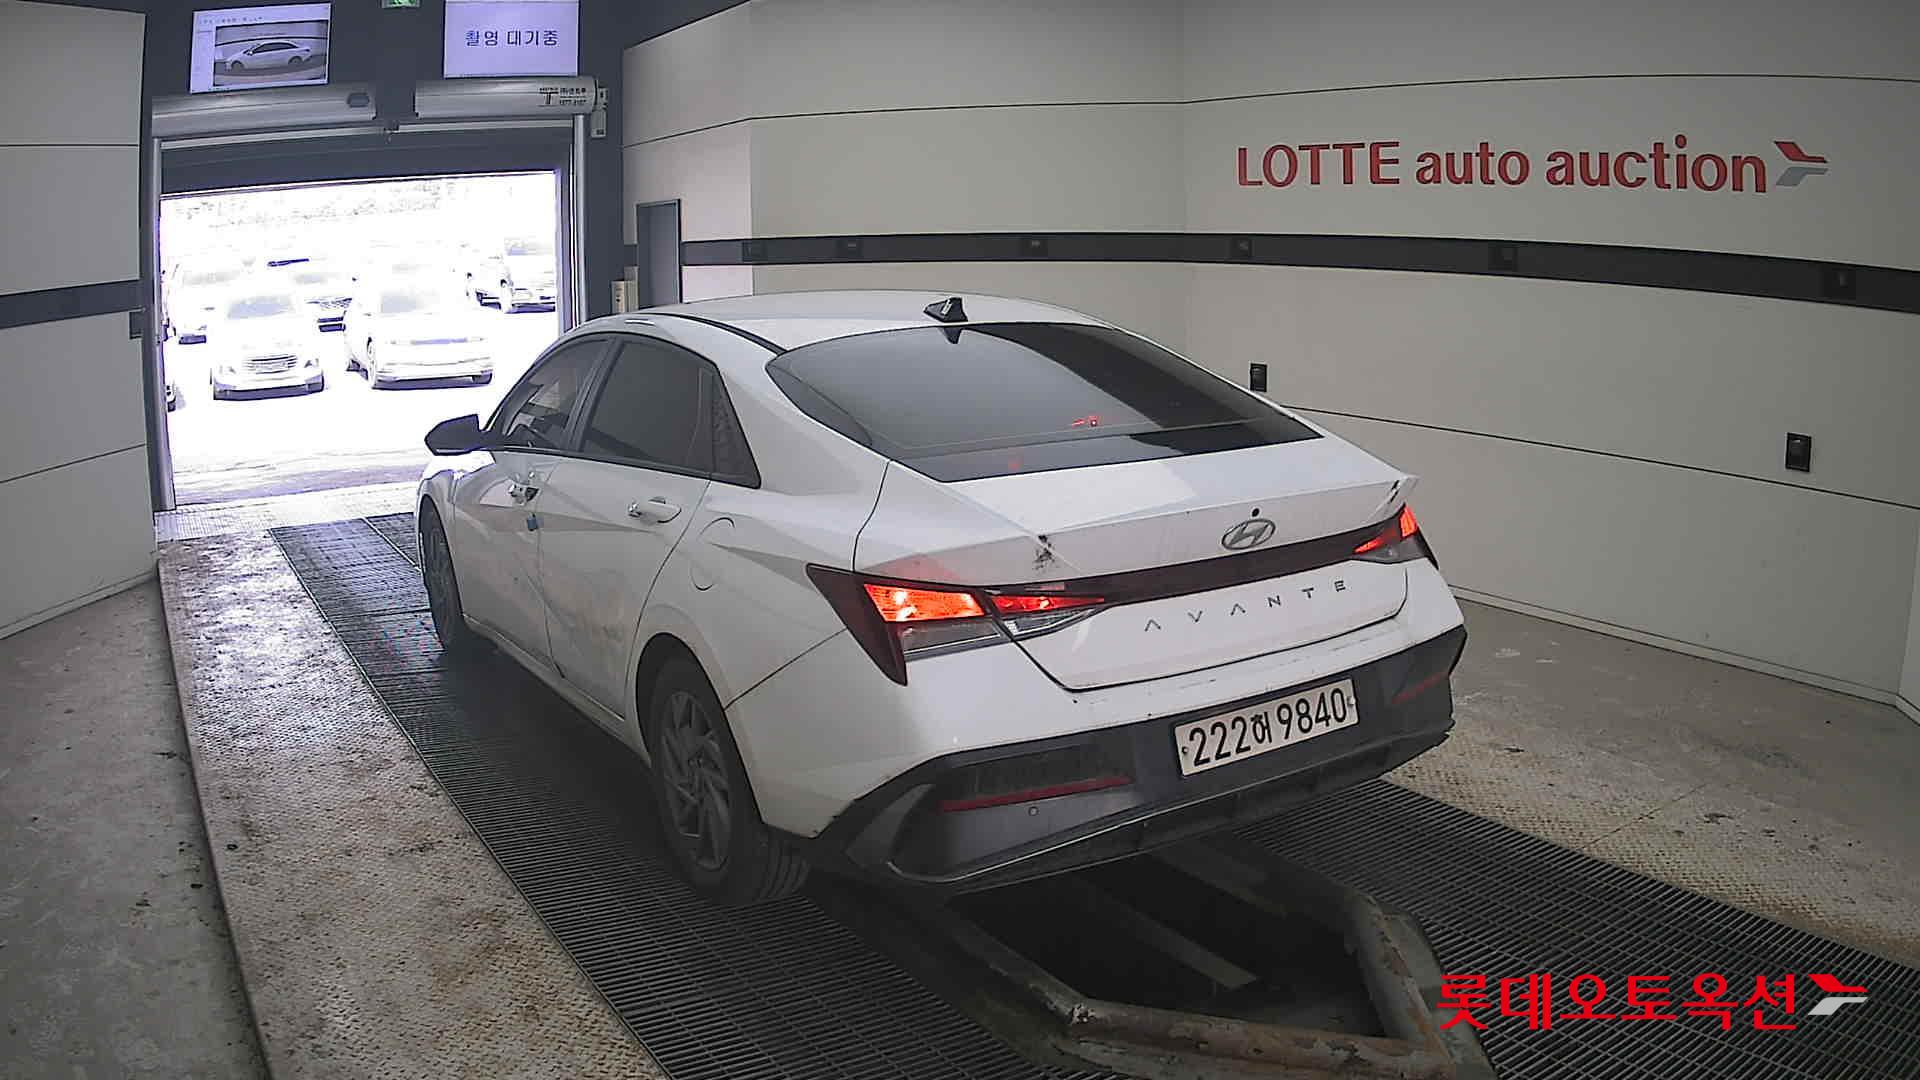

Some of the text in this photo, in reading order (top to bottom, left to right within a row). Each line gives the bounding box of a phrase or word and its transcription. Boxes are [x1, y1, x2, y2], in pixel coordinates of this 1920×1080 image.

[463, 29, 560, 47] 촬영 대기중
[1237, 133, 1768, 193] LOTTE auto auction
[1144, 579, 1347, 632] AVANTE
